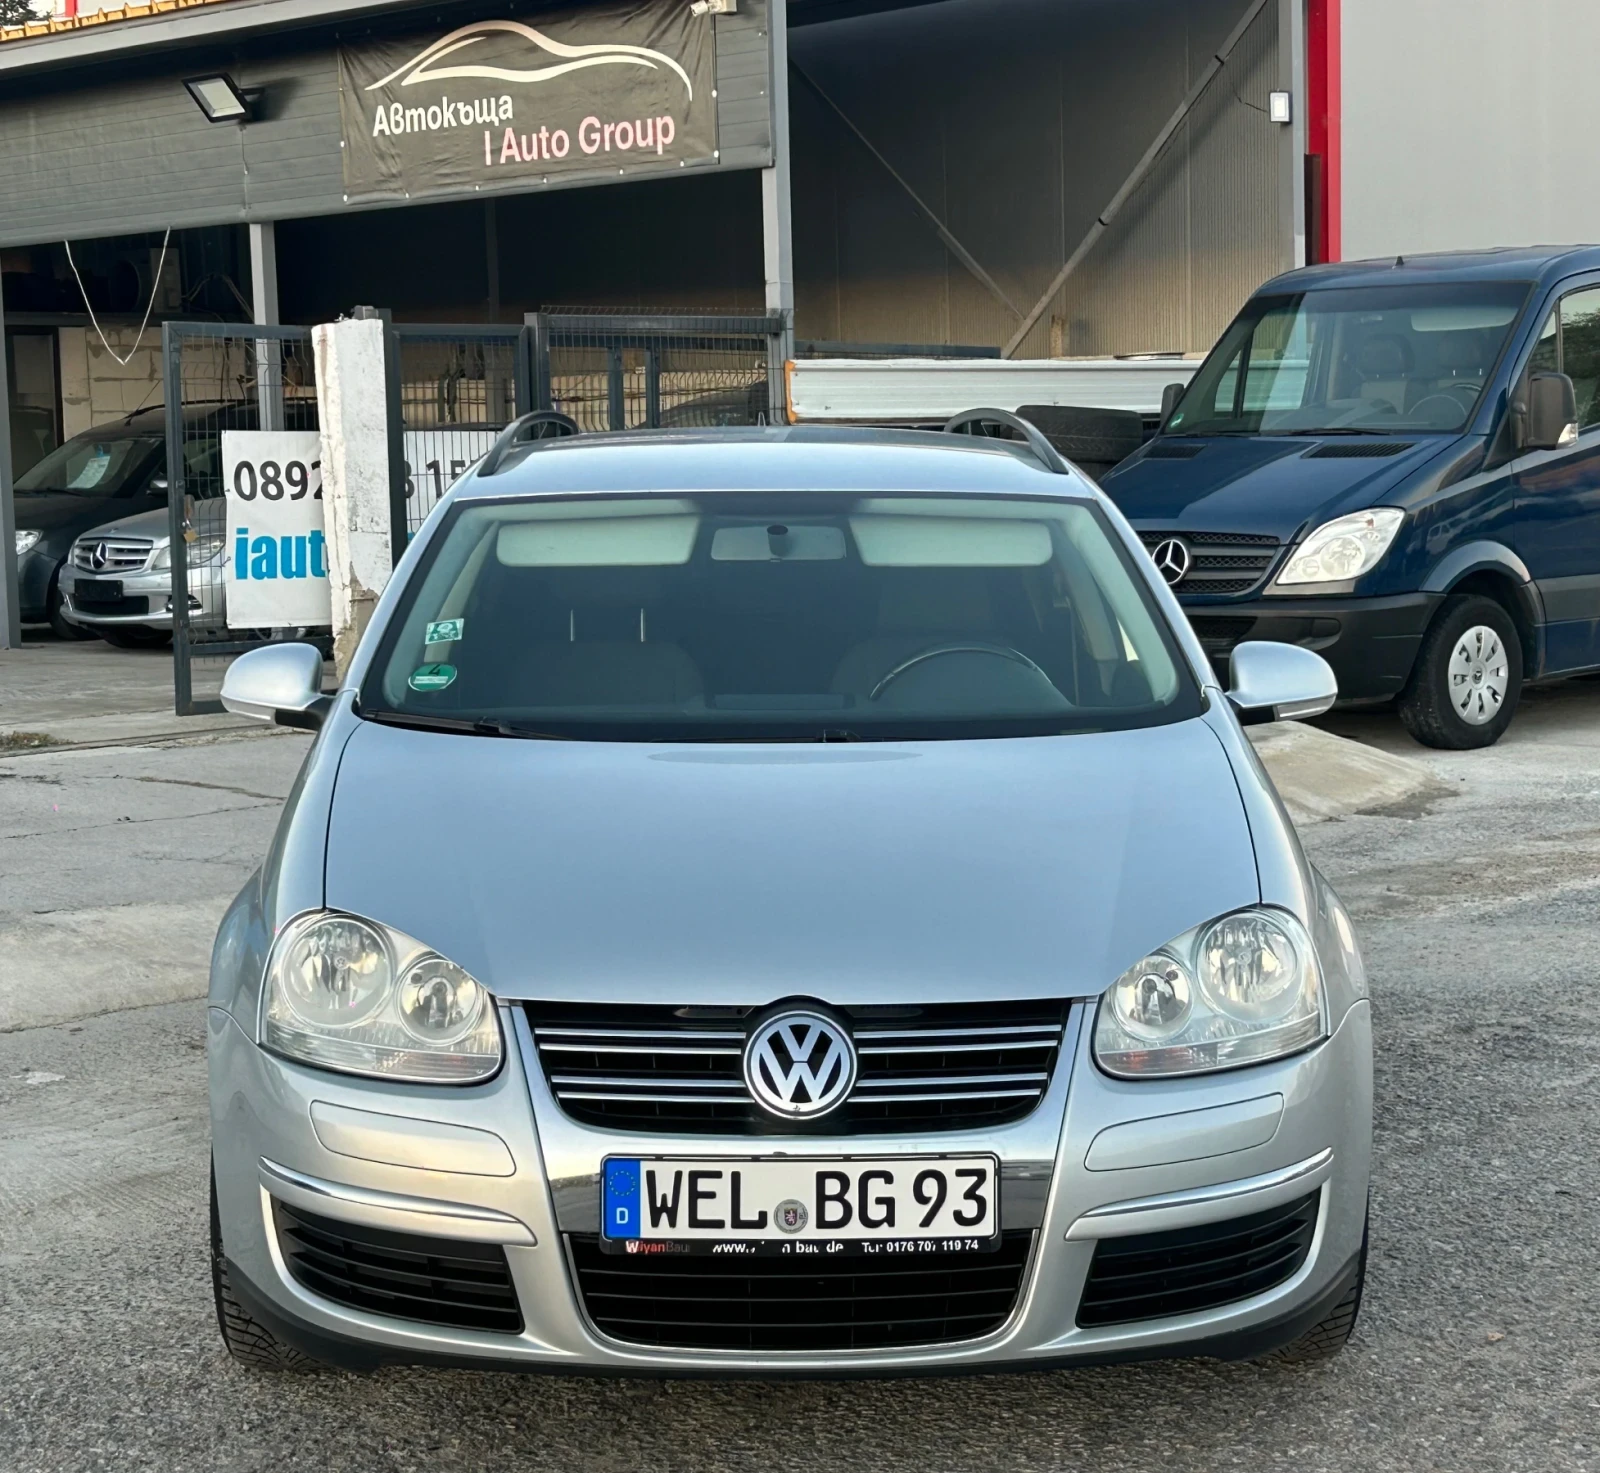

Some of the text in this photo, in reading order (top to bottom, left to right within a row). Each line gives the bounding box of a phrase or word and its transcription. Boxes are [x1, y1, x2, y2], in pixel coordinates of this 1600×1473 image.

[372, 95, 514, 137] Автокъща
[500, 125, 570, 164] Auto
[578, 115, 676, 155] Group
[428, 663, 441, 676] 4
[616, 1207, 629, 1224] D
[645, 1169, 768, 1230] WEL
[815, 1169, 896, 1230] BG
[912, 1168, 988, 1228] 93
[886, 1241, 914, 1252] 0176
[964, 1239, 979, 1251] 74
